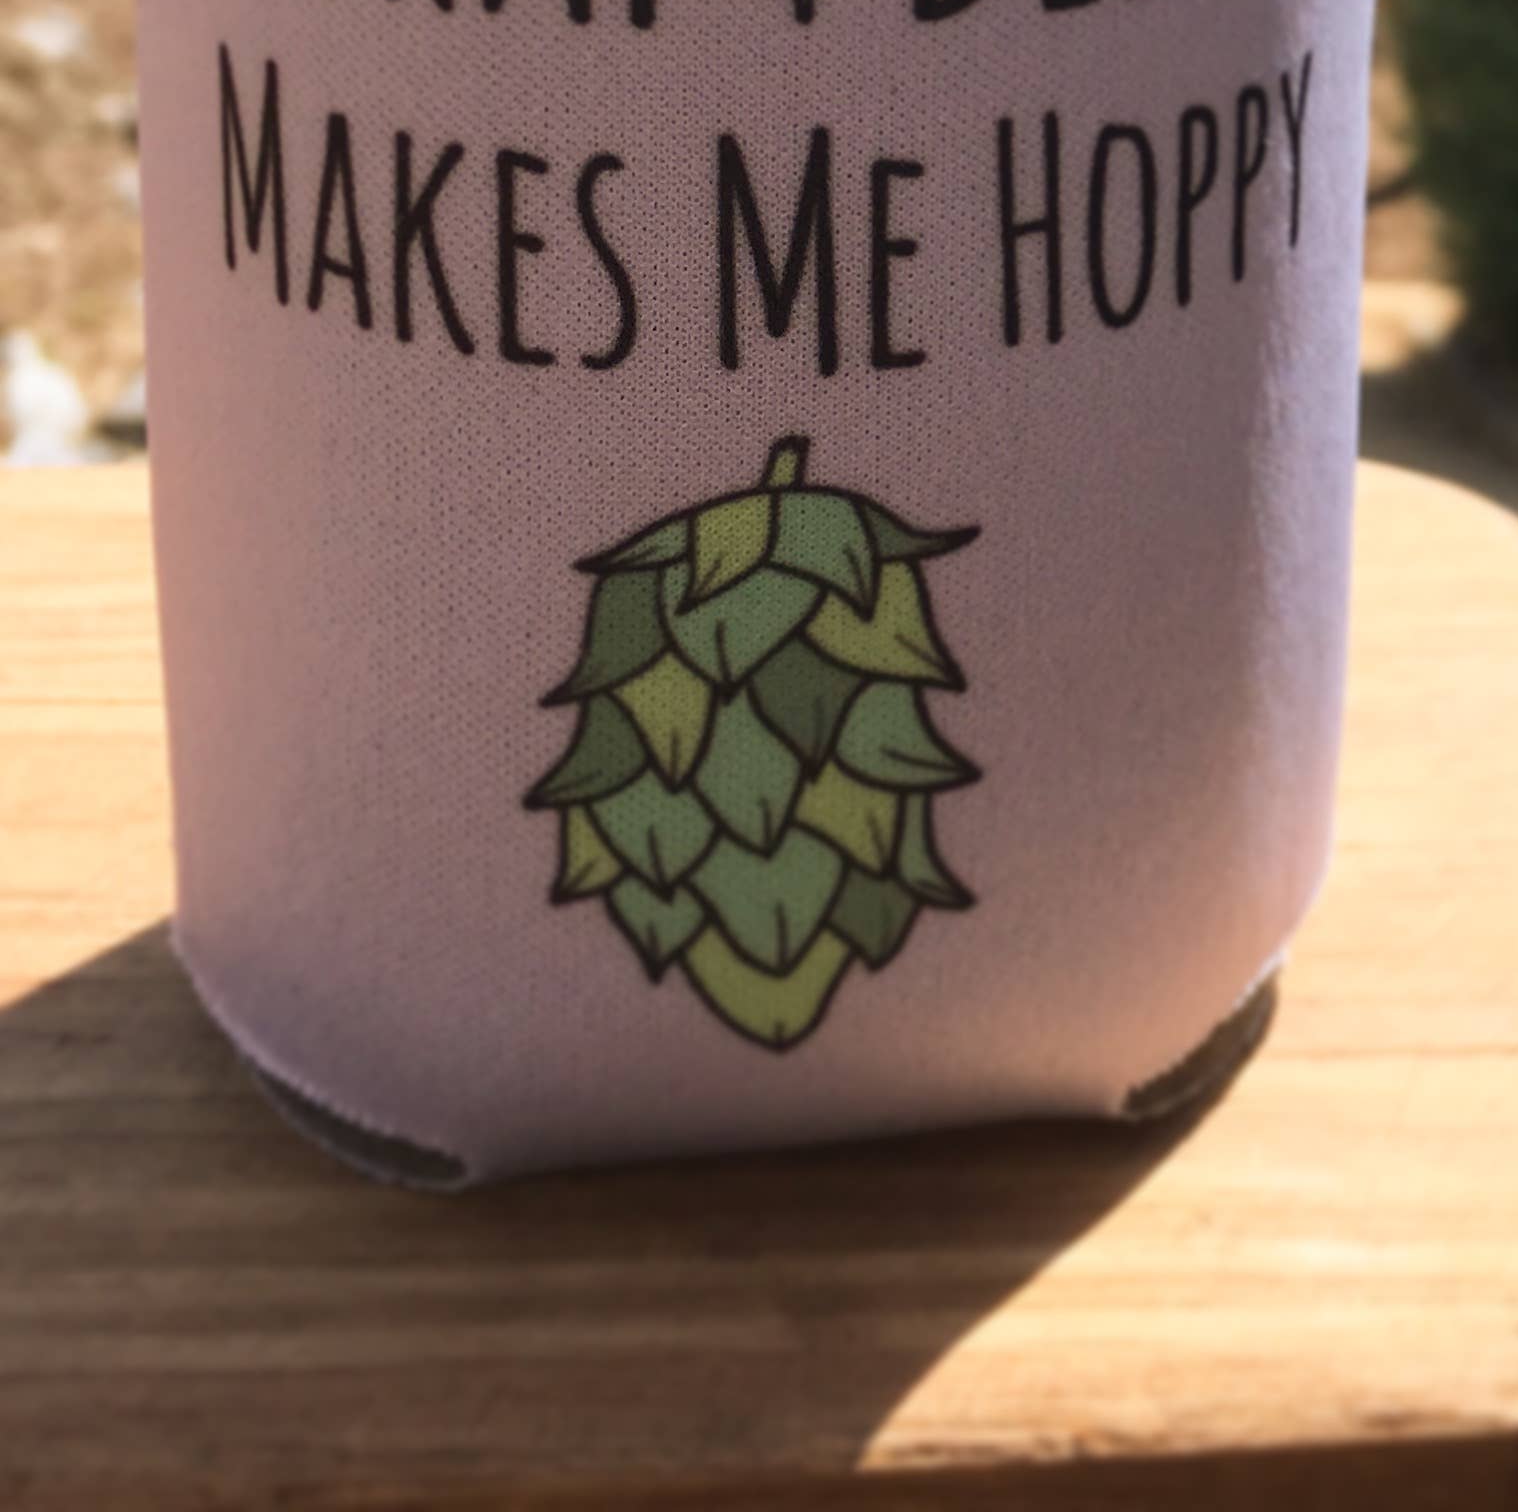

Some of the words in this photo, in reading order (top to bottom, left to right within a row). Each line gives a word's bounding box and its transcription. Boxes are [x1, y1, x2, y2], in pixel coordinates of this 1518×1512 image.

[217, 41, 639, 372] MAKES
[715, 126, 928, 379] ME
[997, 51, 1313, 349] HOPPY
